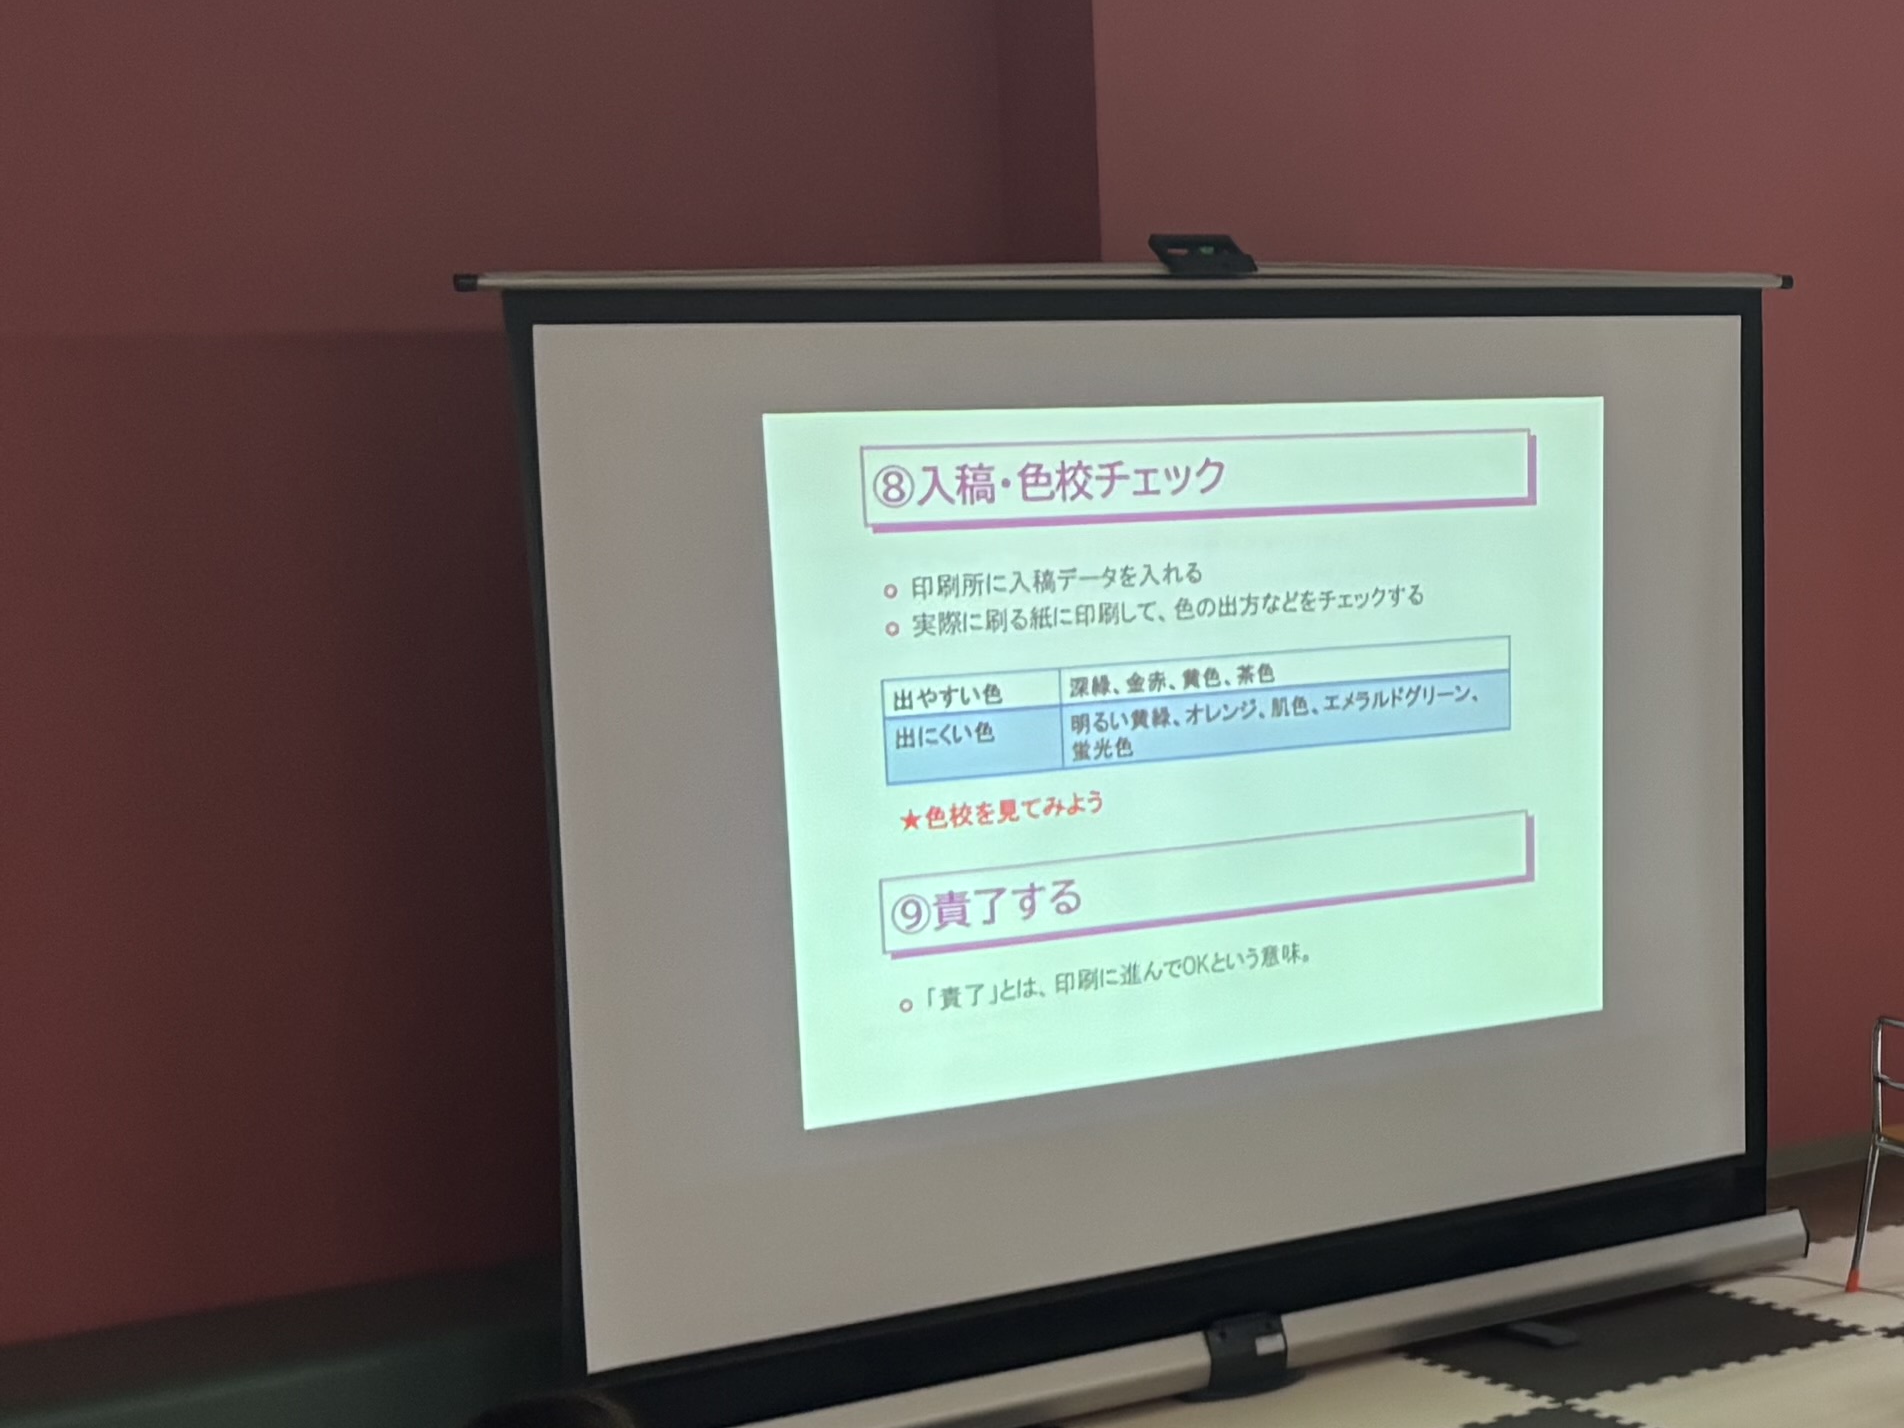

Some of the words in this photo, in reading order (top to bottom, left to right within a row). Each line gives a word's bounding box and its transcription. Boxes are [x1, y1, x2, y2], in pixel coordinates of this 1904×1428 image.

[872, 455, 1227, 509] ⑧入稿・色校チェック
[911, 562, 1203, 600] 印刷所に入稿データを入れる
[912, 584, 1425, 638] 実際に刷る紙に印刷して、色の出方などをチェックする
[893, 683, 1004, 715] 出やすい色
[1069, 662, 1276, 699] 深緑、金赤、黄色、茶色
[894, 721, 996, 750] 出にくい色
[1071, 737, 1134, 760] 蛍光色
[891, 878, 1083, 935] ⑨責了する
